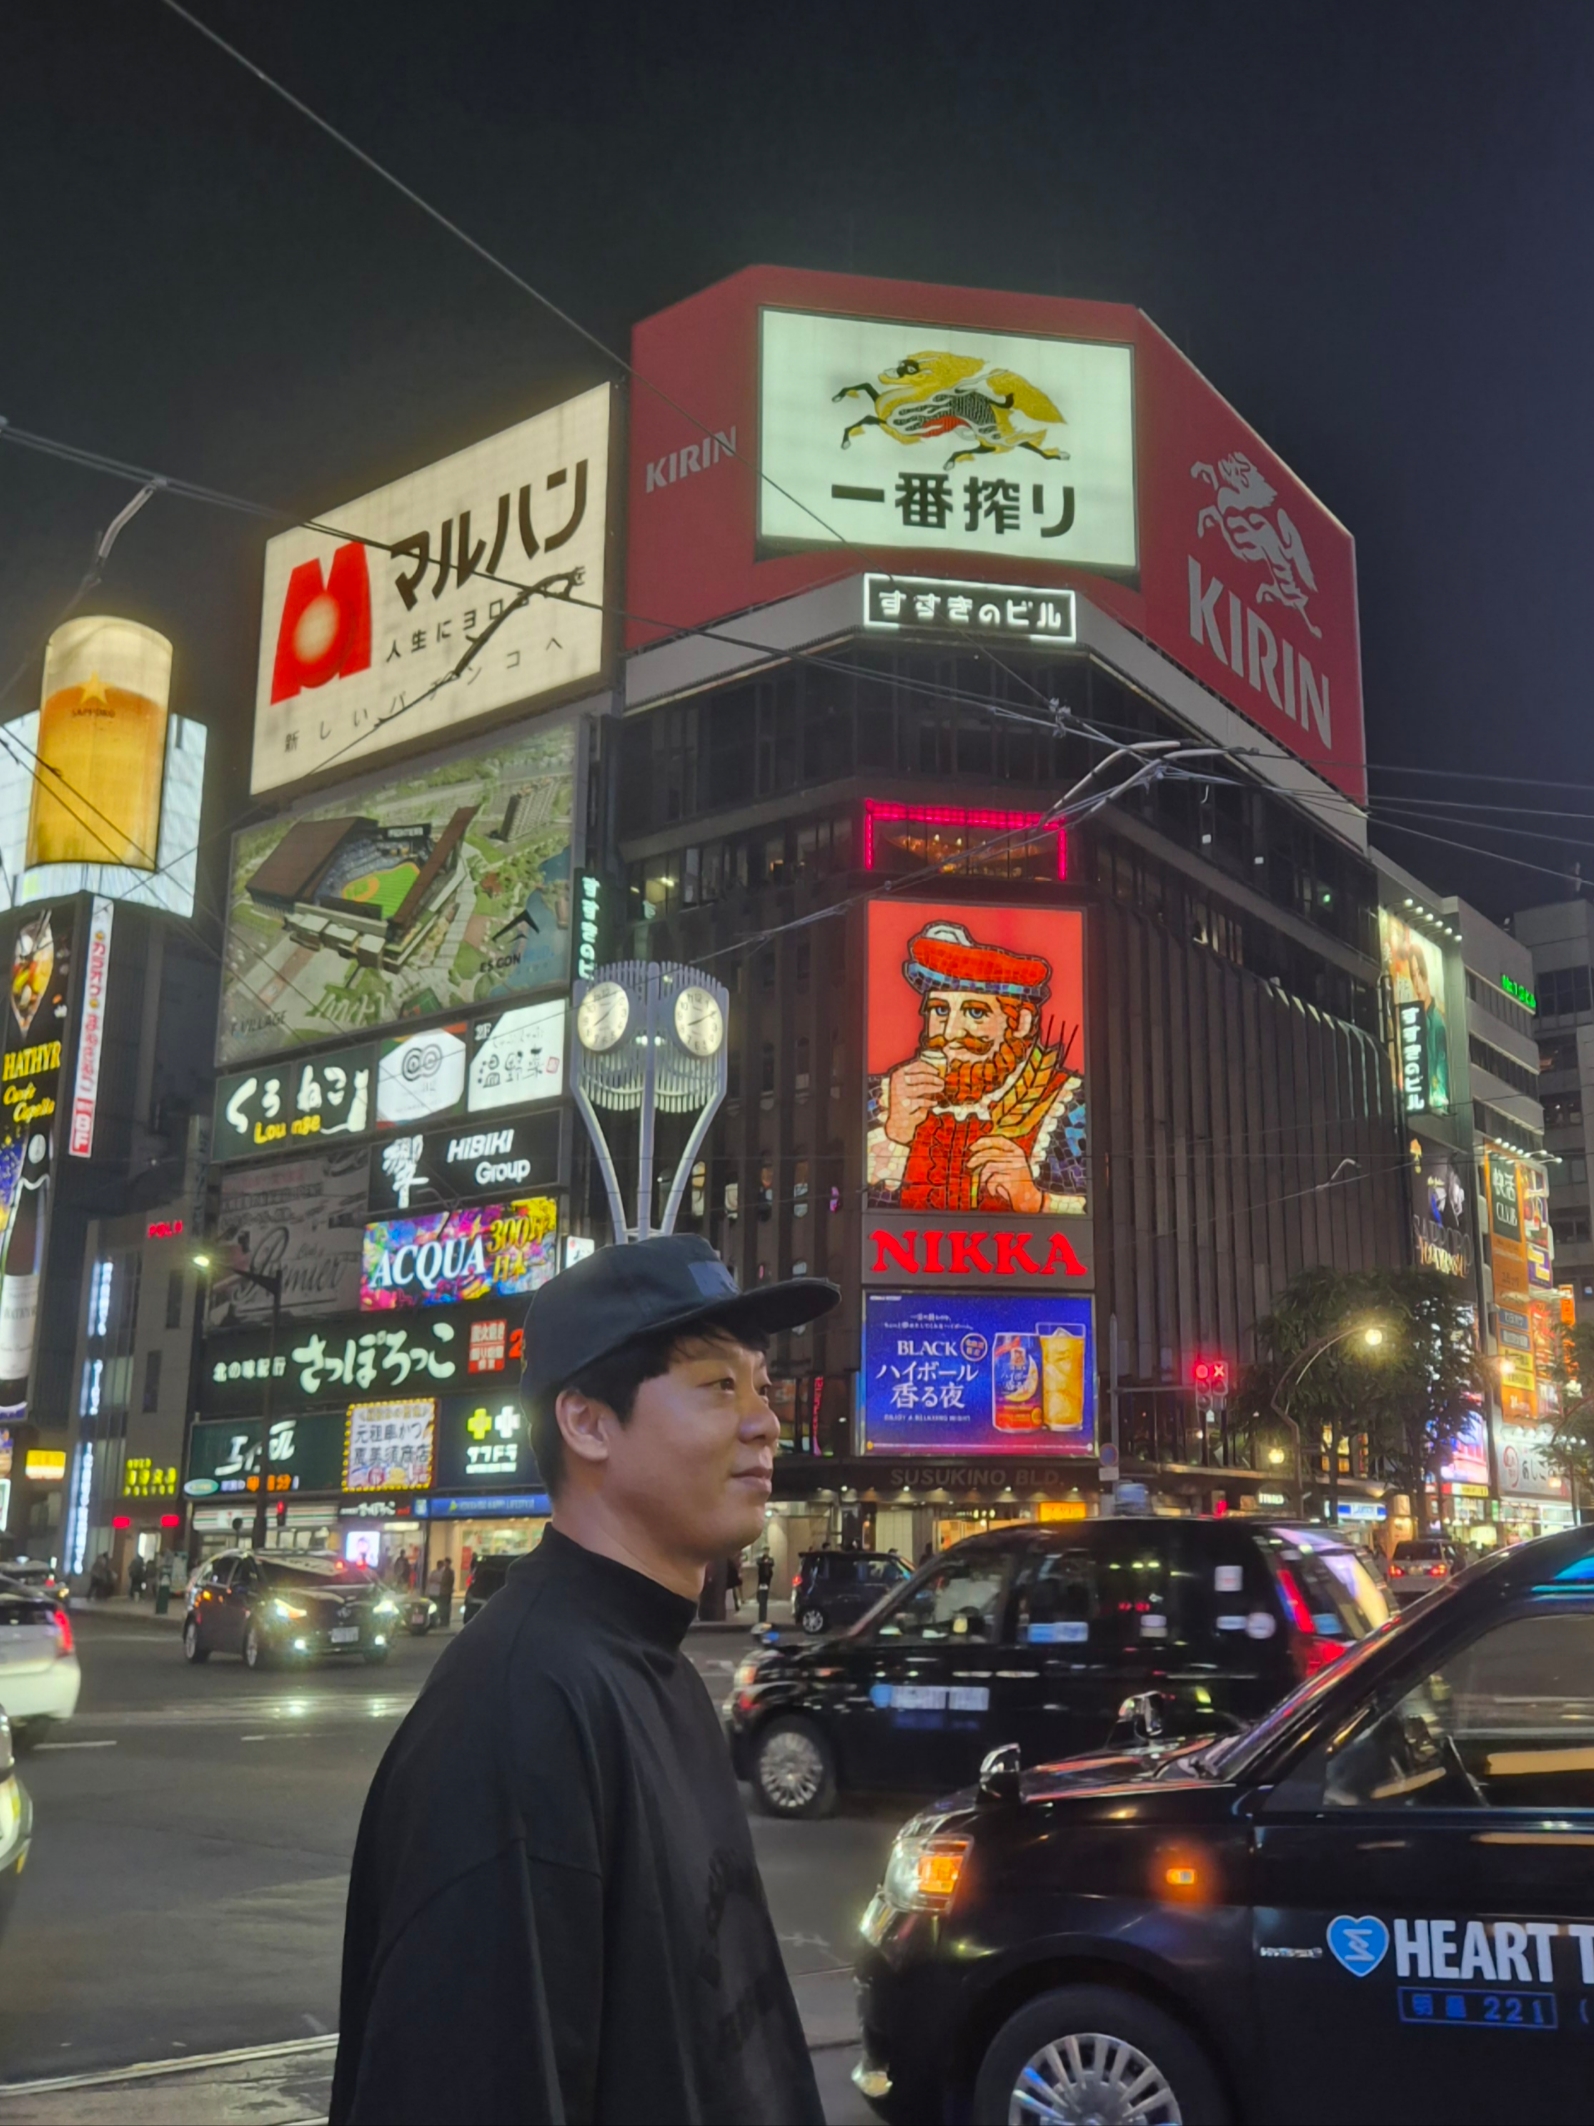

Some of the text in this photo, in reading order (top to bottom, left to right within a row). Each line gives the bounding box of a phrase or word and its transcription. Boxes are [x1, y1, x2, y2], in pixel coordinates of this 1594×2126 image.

[646, 425, 737, 494] KIRIN
[831, 472, 1076, 539] 一番搾り
[390, 458, 588, 612] マルハン
[879, 589, 1062, 630] すすきのビル
[1187, 554, 1332, 750] KIRIN
[496, 953, 522, 970] CON
[475, 1023, 492, 1041] 2F
[475, 1159, 531, 1185] Group
[368, 1235, 487, 1290] ACQUA
[869, 1229, 1088, 1276] NIKKA
[291, 1322, 456, 1394] さっぽろっこ
[897, 1340, 958, 1356] BLACK
[875, 1360, 979, 1383] ハイボール
[890, 1382, 966, 1409] 香る夜
[890, 1467, 1065, 1487] SUSUKINO BLD.
[1393, 1917, 1560, 1984] HEART
[1483, 1995, 1545, 2026] 221
